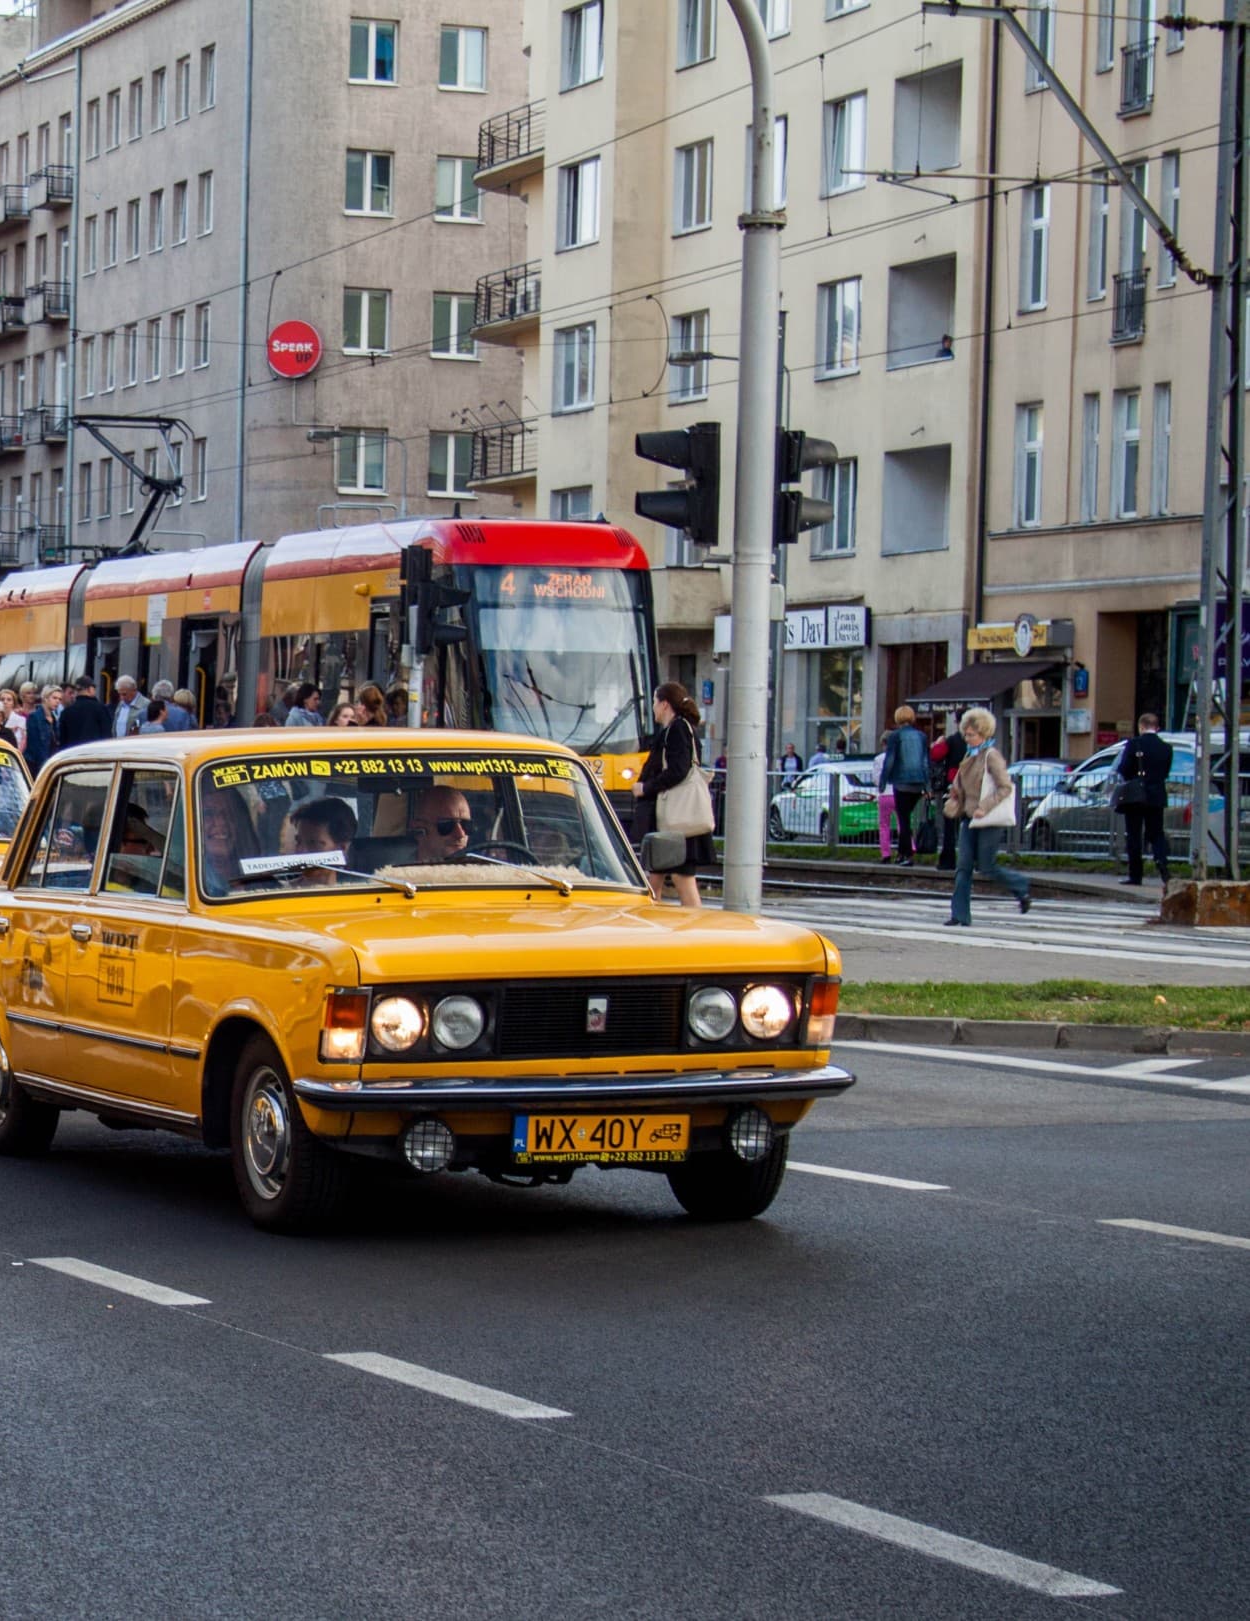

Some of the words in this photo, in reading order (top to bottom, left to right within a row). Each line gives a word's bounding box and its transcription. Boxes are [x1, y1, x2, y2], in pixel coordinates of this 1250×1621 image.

[296, 353, 312, 363] UP
[500, 570, 515, 596] 4
[534, 584, 605, 599] WSCHODNI
[834, 611, 856, 621] Jean
[835, 621, 859, 631] Louis
[835, 631, 860, 641] David
[251, 760, 309, 780] ZAMÓW
[334, 761, 359, 775] +22
[362, 760, 385, 775] 882
[388, 759, 405, 774] 13
[407, 759, 424, 774] 13
[429, 760, 547, 777] www.wpt1313.com
[535, 1119, 578, 1149] WX
[590, 1118, 645, 1149] 40Y
[533, 1153, 600, 1163] www.wpt1313.com
[610, 1153, 625, 1161] +22
[627, 1153, 643, 1161] 882
[646, 1152, 656, 1161] 13
[659, 1152, 669, 1160] 13
